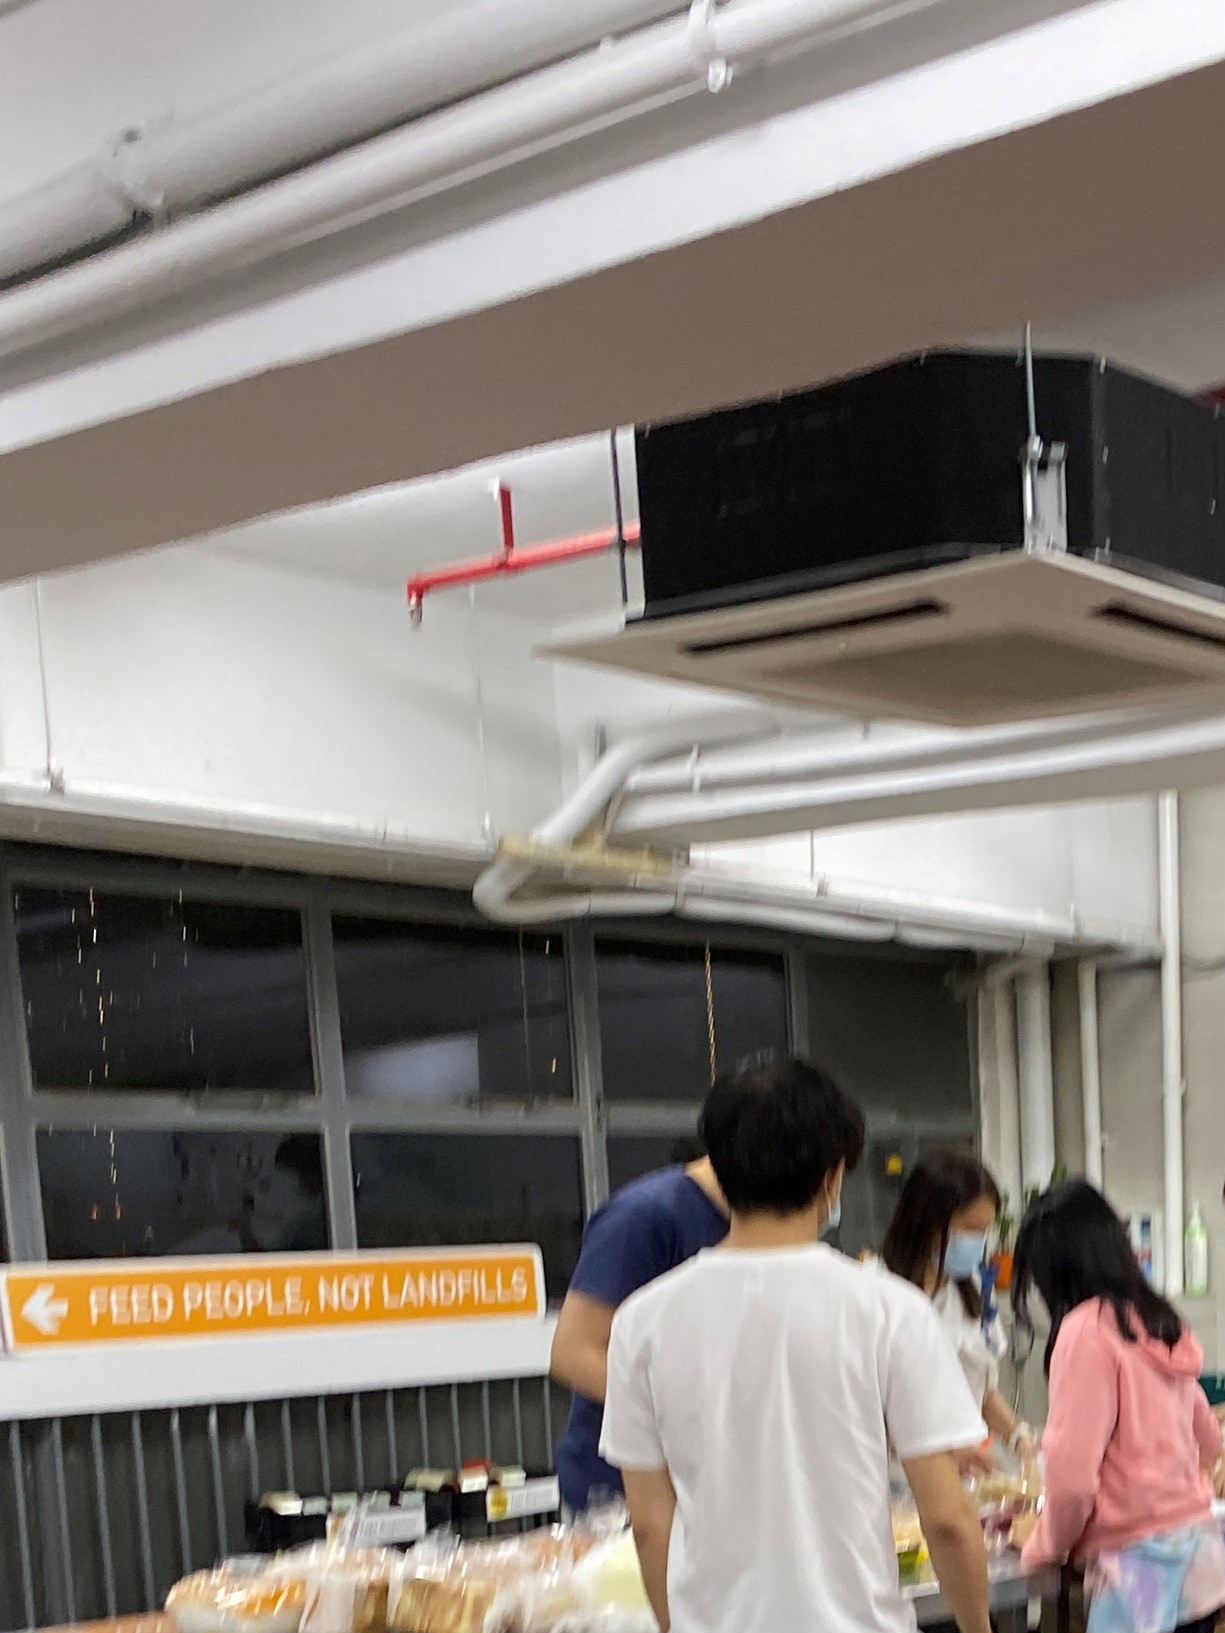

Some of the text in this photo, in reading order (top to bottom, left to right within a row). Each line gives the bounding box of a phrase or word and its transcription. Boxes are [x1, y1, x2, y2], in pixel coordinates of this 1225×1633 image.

[89, 1266, 527, 1326] FEED PEOPLE, NOT LANDFILLS
